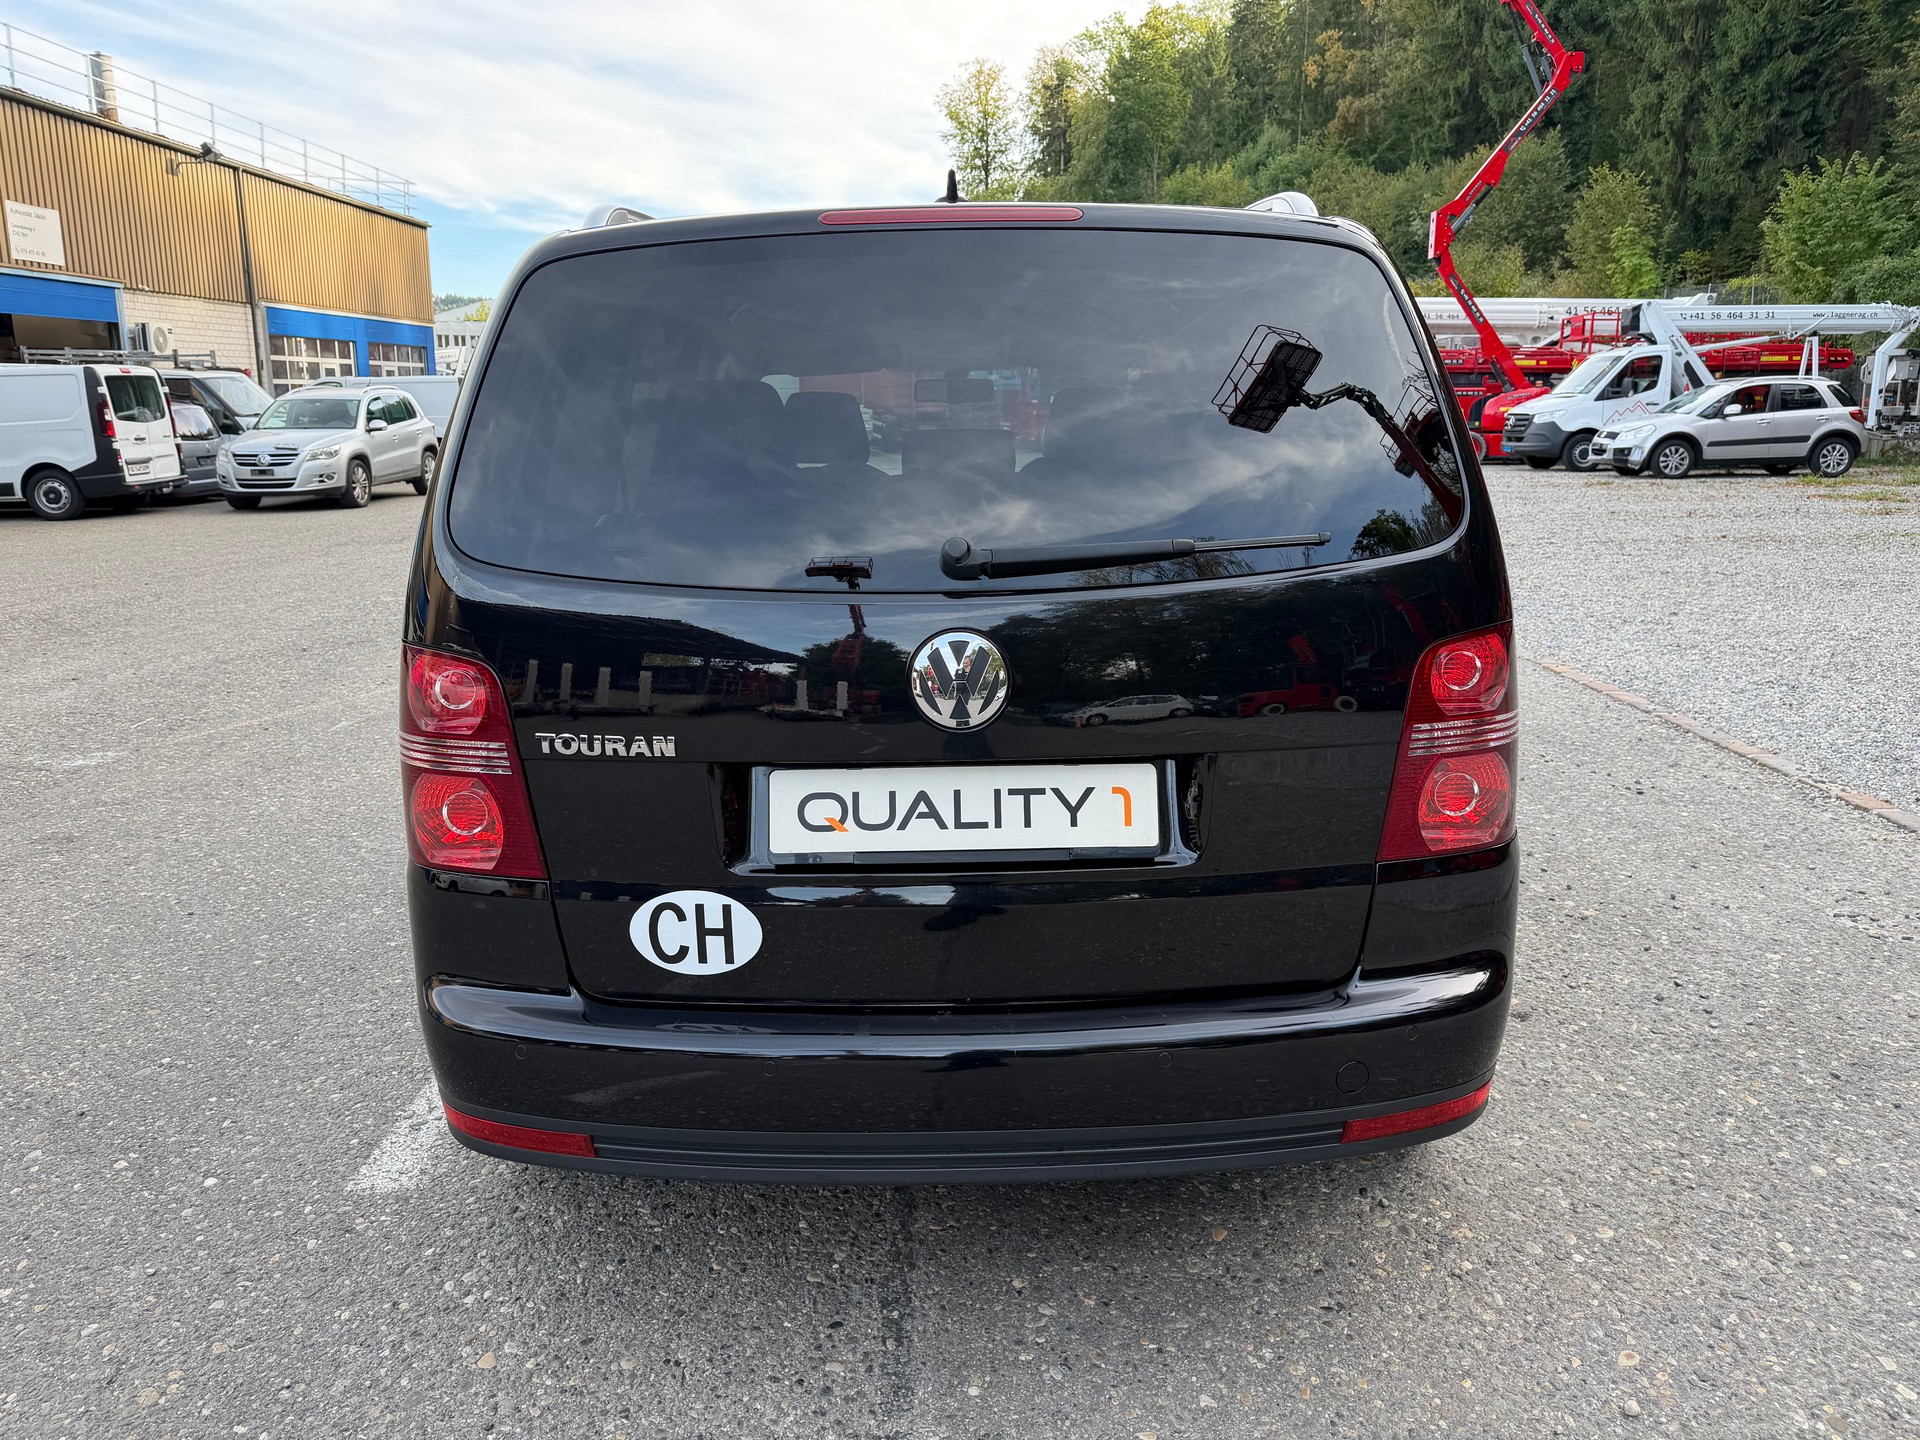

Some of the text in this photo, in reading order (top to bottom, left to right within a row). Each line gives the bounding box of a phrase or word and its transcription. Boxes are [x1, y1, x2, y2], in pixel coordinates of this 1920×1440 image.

[1689, 311, 1775, 320] +41 56 464 31 31
[1812, 311, 1878, 319] www.laggnerag.ch
[535, 732, 676, 757] TOURAN
[797, 786, 1131, 832] QUALITY 1
[648, 901, 735, 965] CH
